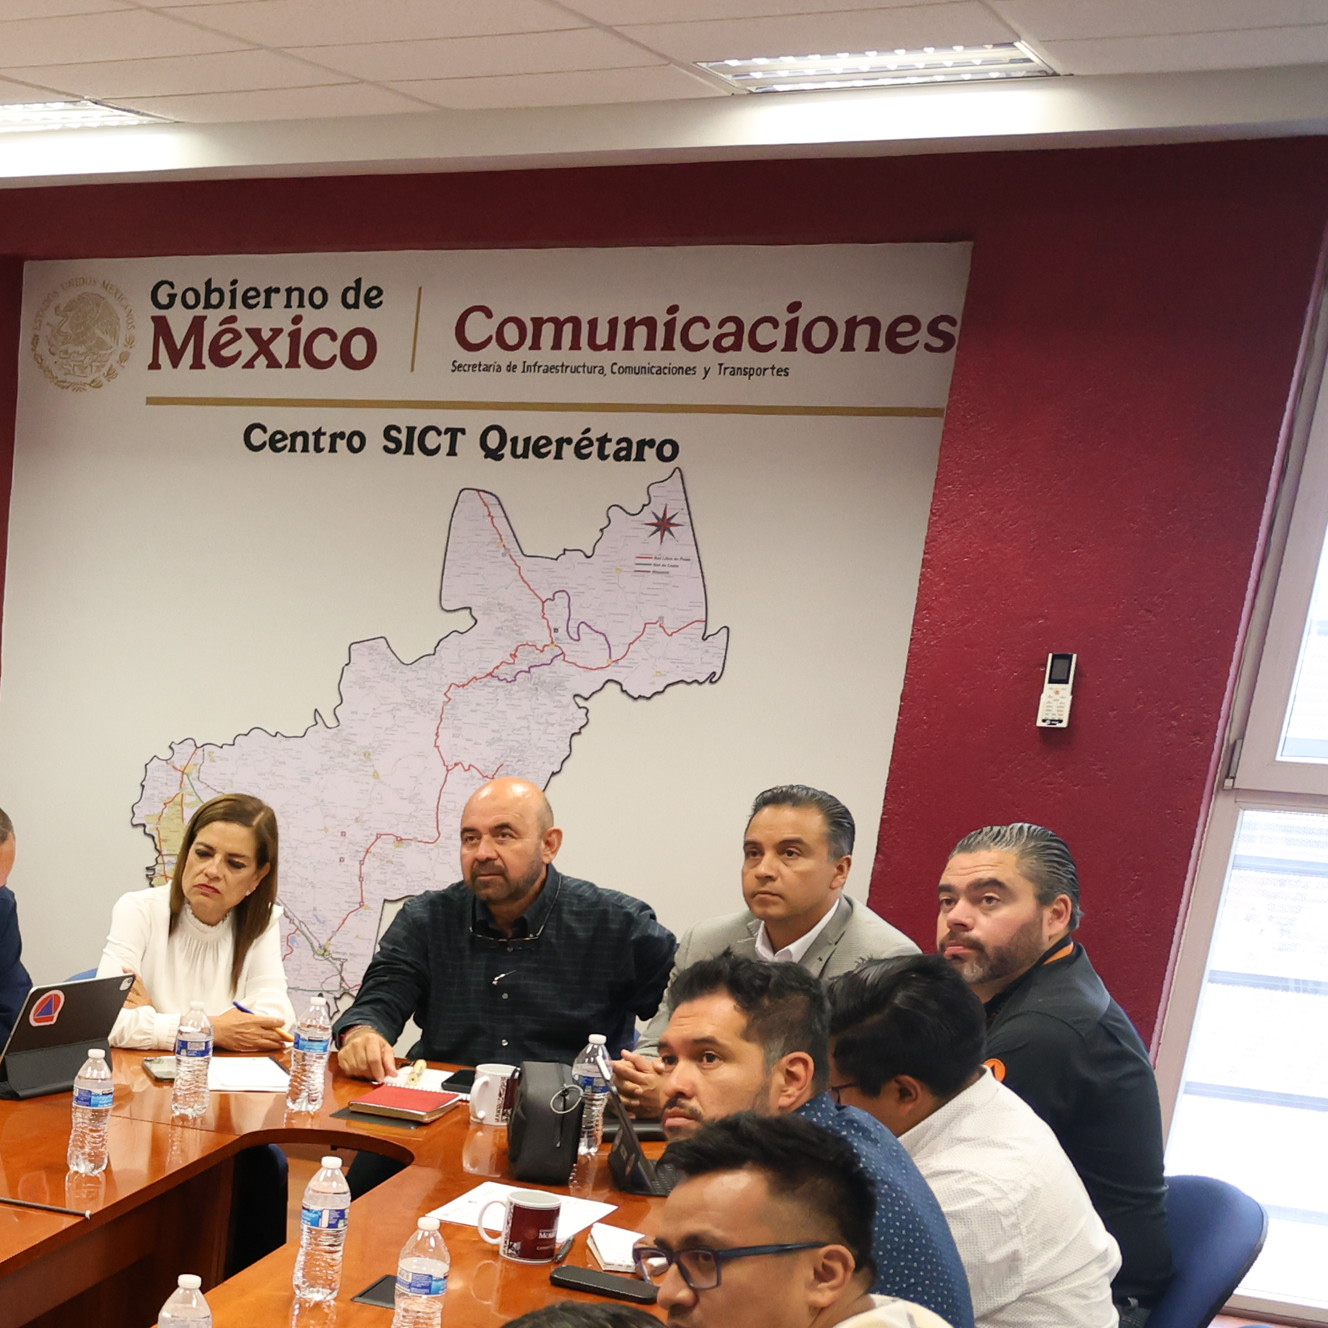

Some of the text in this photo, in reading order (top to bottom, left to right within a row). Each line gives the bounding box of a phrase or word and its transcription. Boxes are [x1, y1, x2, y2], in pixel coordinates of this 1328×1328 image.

[150, 276, 384, 311] Gobierno de
[147, 314, 378, 371] México
[454, 300, 962, 359] Comunicaciones
[505, 360, 518, 373] de
[520, 360, 607, 377] Infraestructura,
[610, 361, 697, 376] Comunicaciones
[702, 366, 711, 381] y
[717, 362, 790, 381] Transportes
[243, 422, 680, 469] Centro SICT Querétaro
